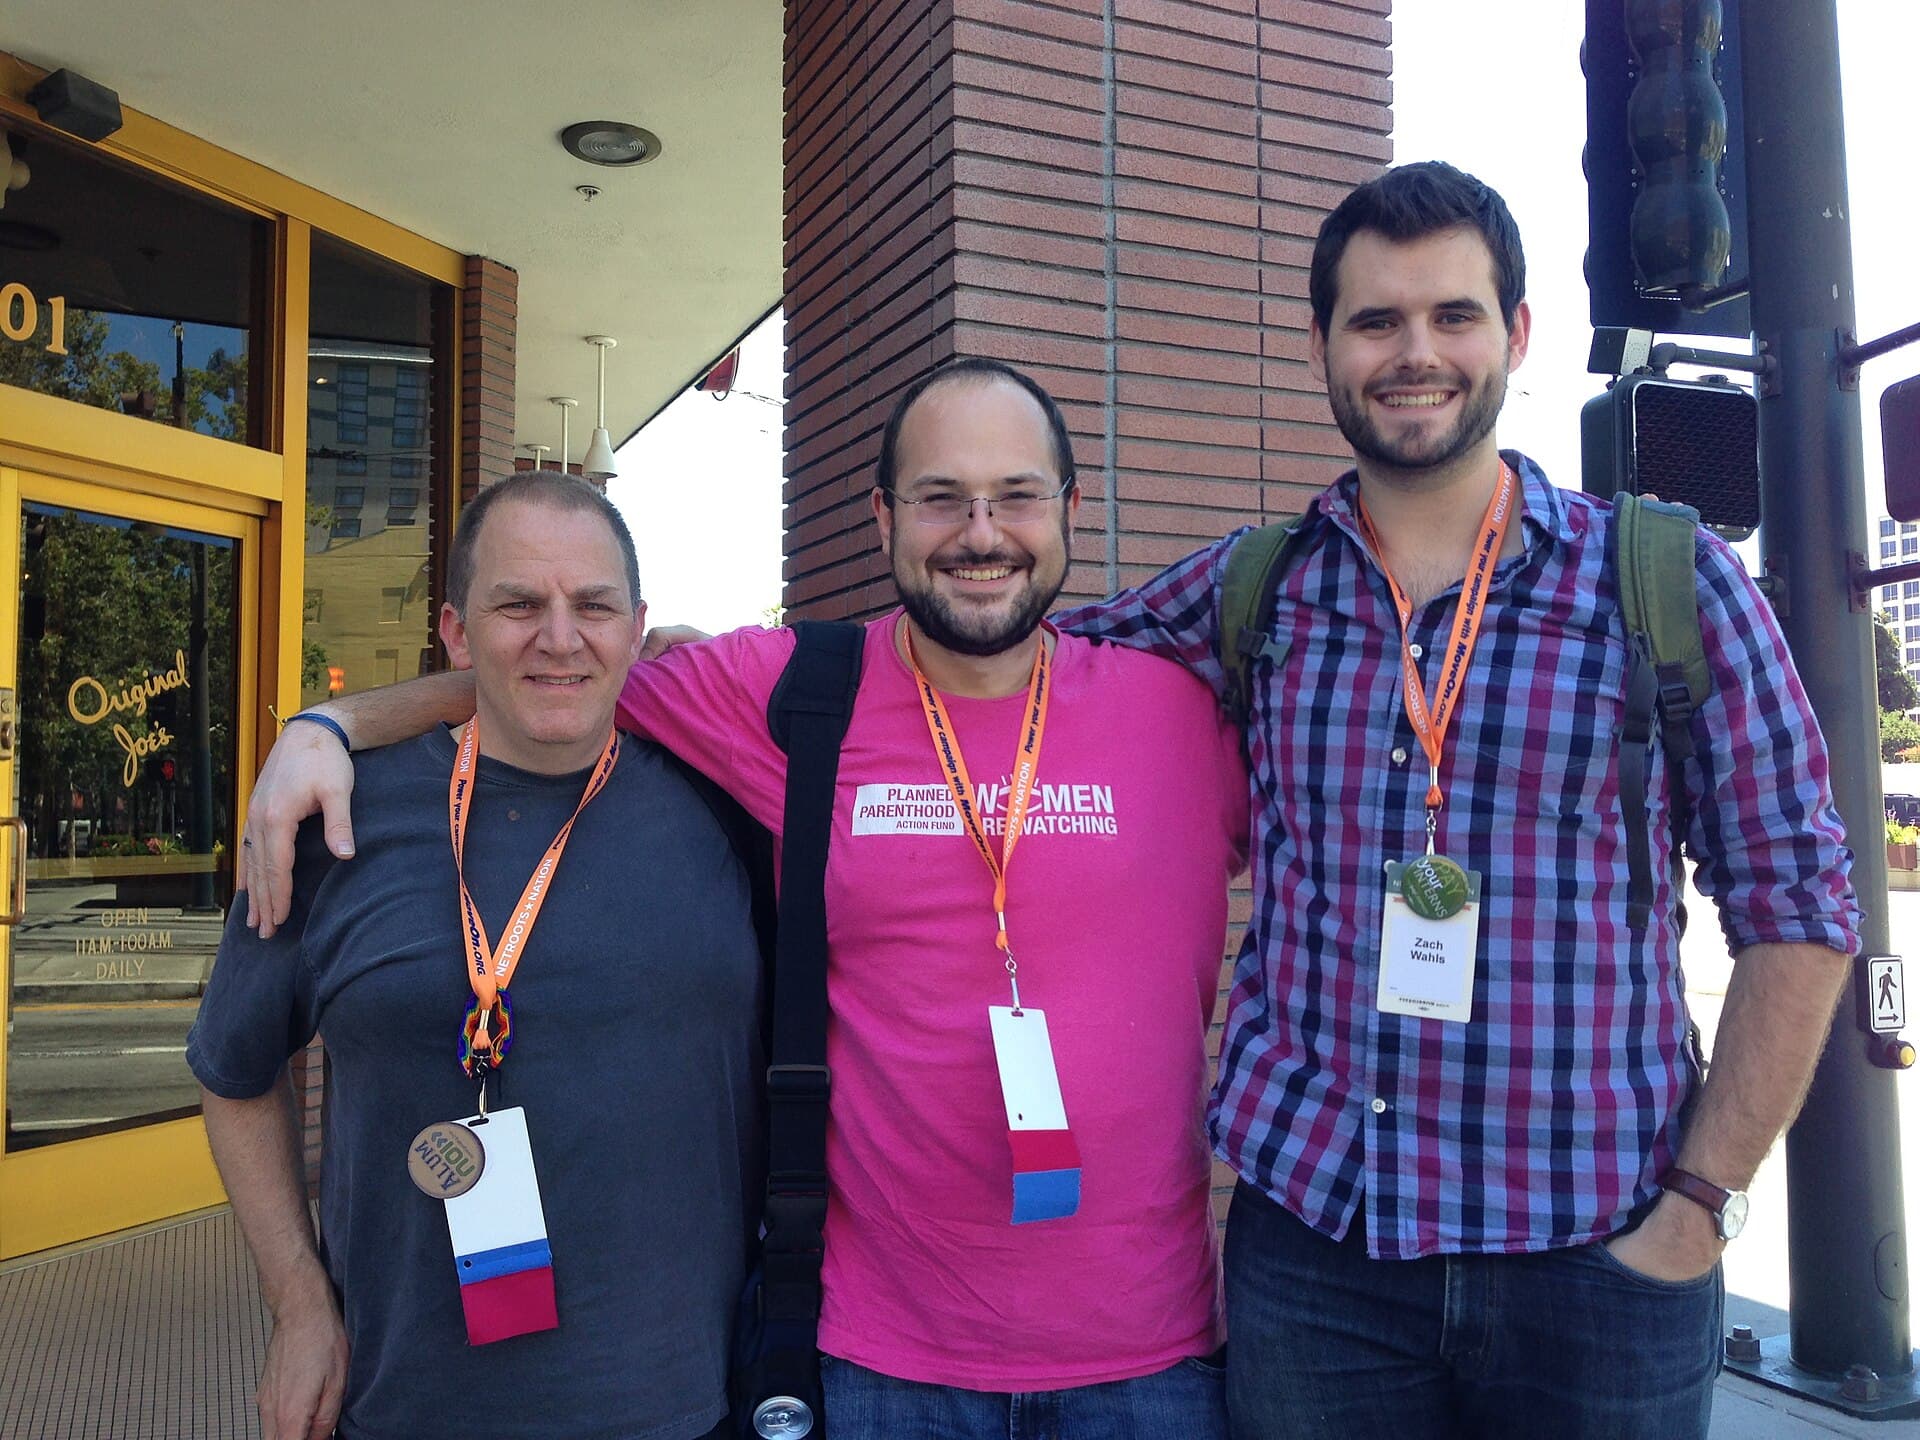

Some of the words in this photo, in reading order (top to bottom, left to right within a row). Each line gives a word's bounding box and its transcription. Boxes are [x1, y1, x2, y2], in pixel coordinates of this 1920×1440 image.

[1491, 488, 1510, 523] NATION
[1466, 572, 1484, 616] campaign
[1460, 617, 1472, 640] with
[68, 649, 190, 724] Original
[113, 720, 175, 787] Joe's
[938, 731, 958, 773] campaign
[953, 776, 965, 796] with
[888, 788, 954, 802] PLANNED
[1015, 762, 1031, 805] NATION
[859, 804, 955, 818] PARENTHOOD
[896, 820, 928, 830] ACTION
[931, 820, 955, 830] FUND
[1019, 815, 1118, 836] WATCHING
[1416, 859, 1443, 889] your
[1413, 869, 1448, 918] INTERNS
[101, 908, 148, 928] OPEN
[494, 911, 531, 977] NETROOTS
[527, 858, 553, 901] NATION
[1410, 950, 1446, 965] Wahls
[1414, 937, 1443, 951] Zach
[96, 959, 145, 980] DAILY
[415, 1139, 461, 1191] ALUM
